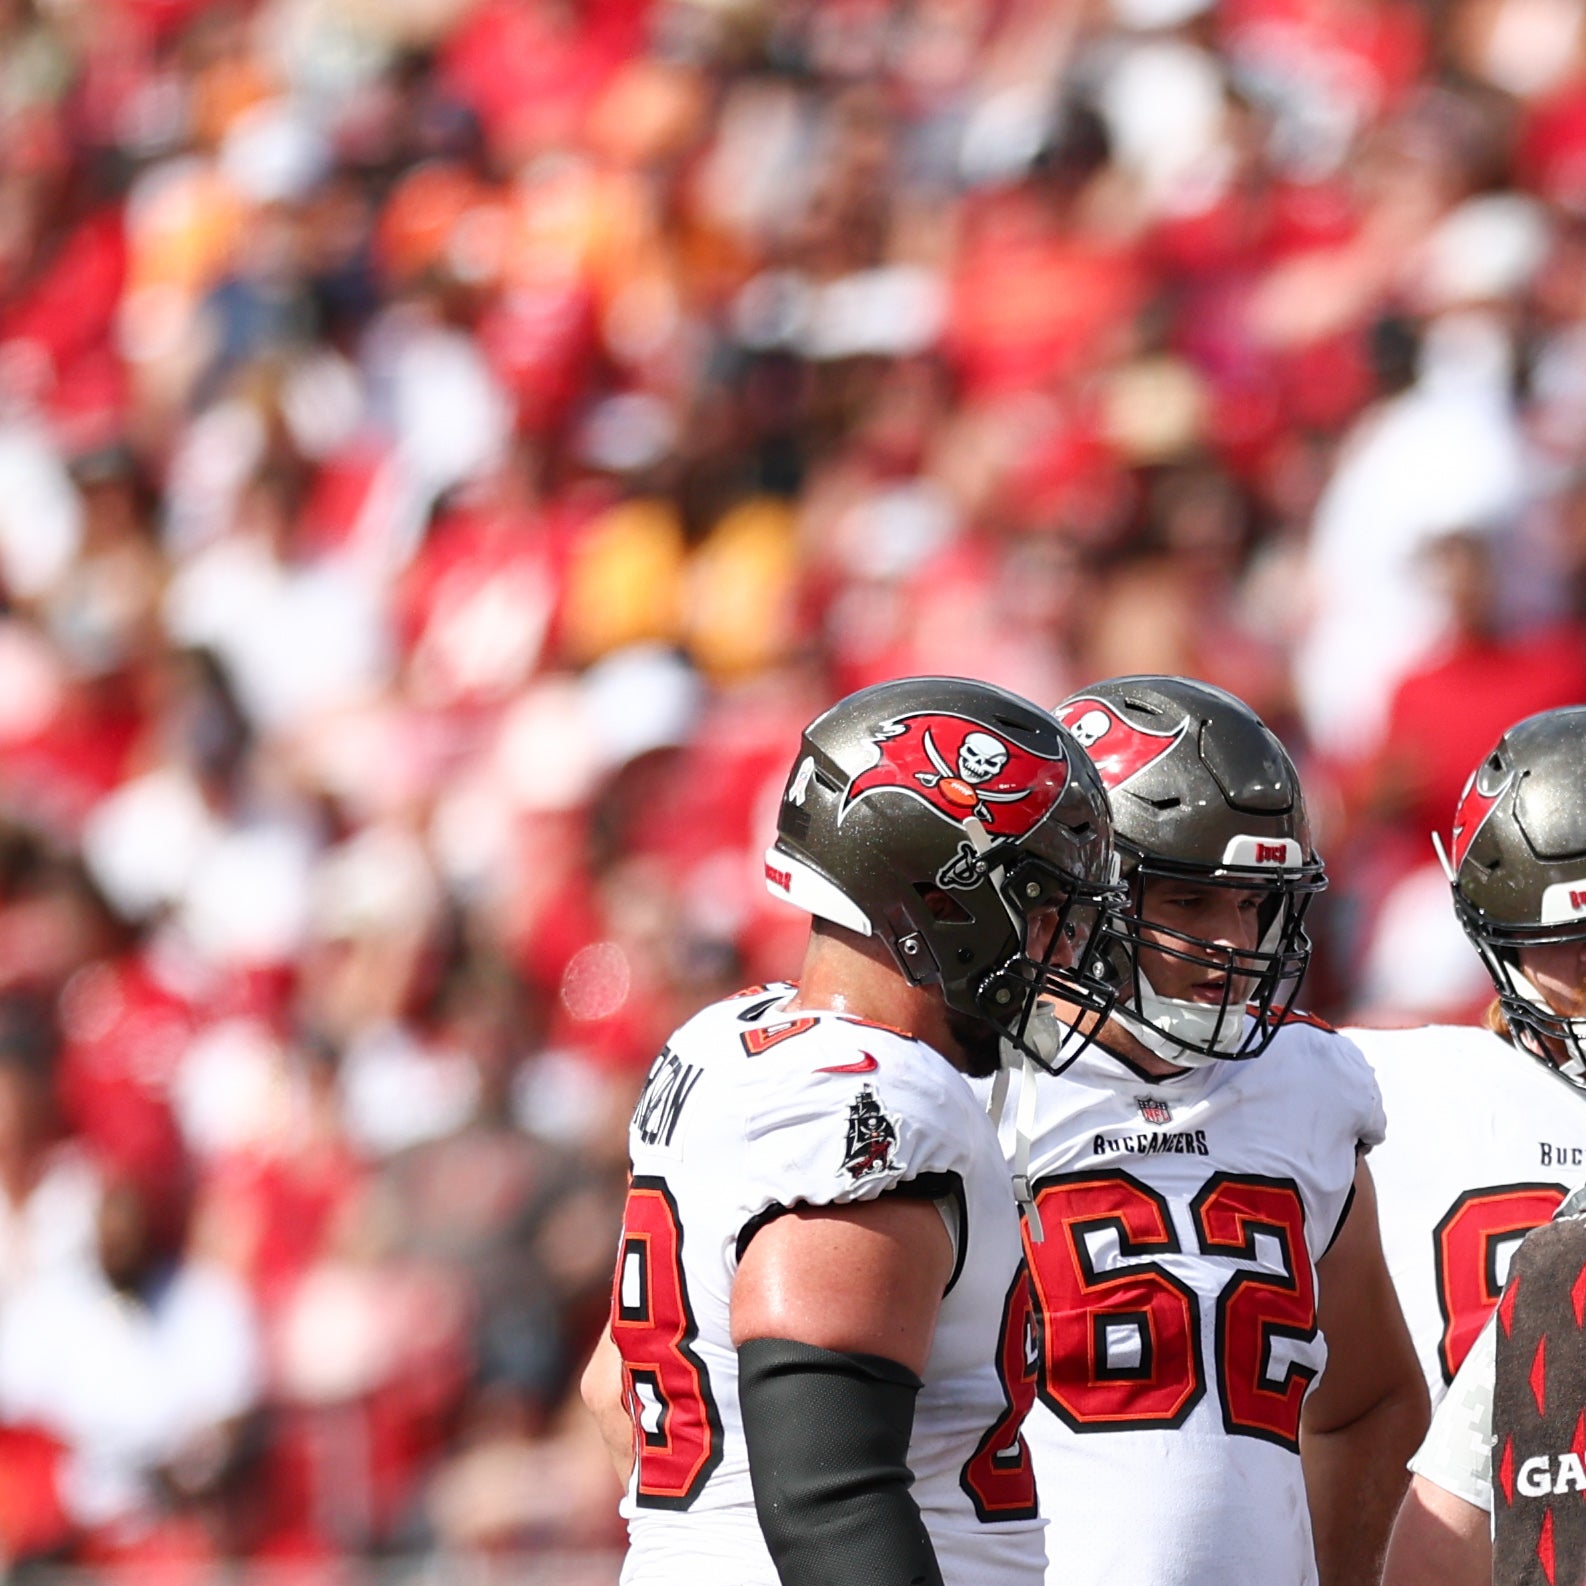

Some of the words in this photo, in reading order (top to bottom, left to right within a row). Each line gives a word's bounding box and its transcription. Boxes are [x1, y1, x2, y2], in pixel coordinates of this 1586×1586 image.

[1256, 842, 1287, 864] BUCS
[1093, 1130, 1209, 1156] BUCCANEERS
[1018, 1168, 1319, 1455] 62
